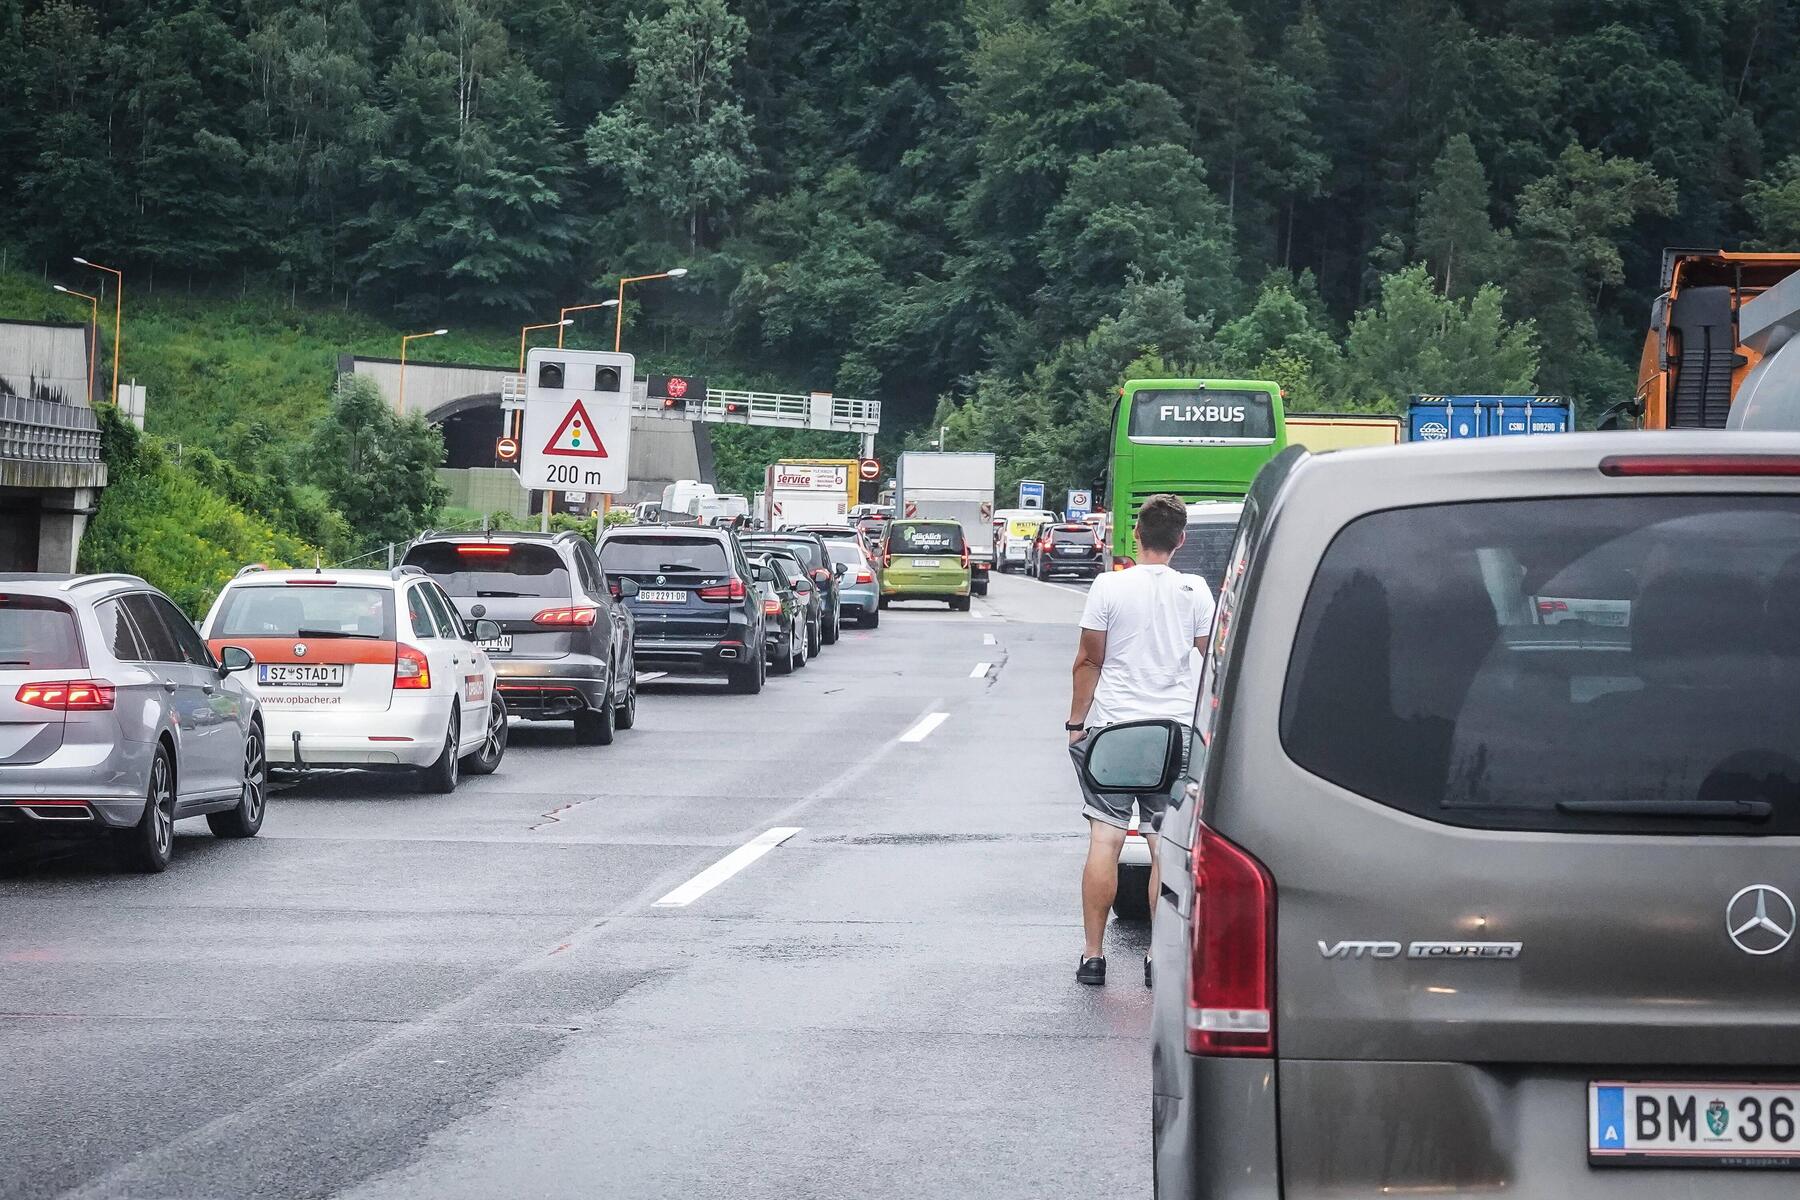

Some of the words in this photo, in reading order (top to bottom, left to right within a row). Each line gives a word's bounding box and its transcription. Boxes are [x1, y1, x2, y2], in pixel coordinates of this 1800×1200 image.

[546, 464, 579, 484] 200
[585, 471, 601, 485] m
[777, 473, 811, 485] Service
[640, 591, 651, 600] BG
[271, 667, 286, 680] SZ
[296, 667, 328, 680] STAD
[260, 695, 342, 705] www.opbacher.at
[1317, 939, 1403, 959] VITO
[1412, 943, 1518, 957] TOURER
[1635, 1094, 1697, 1142] BM
[1738, 1096, 1795, 1143] 36
[1604, 1125, 1619, 1141] A
